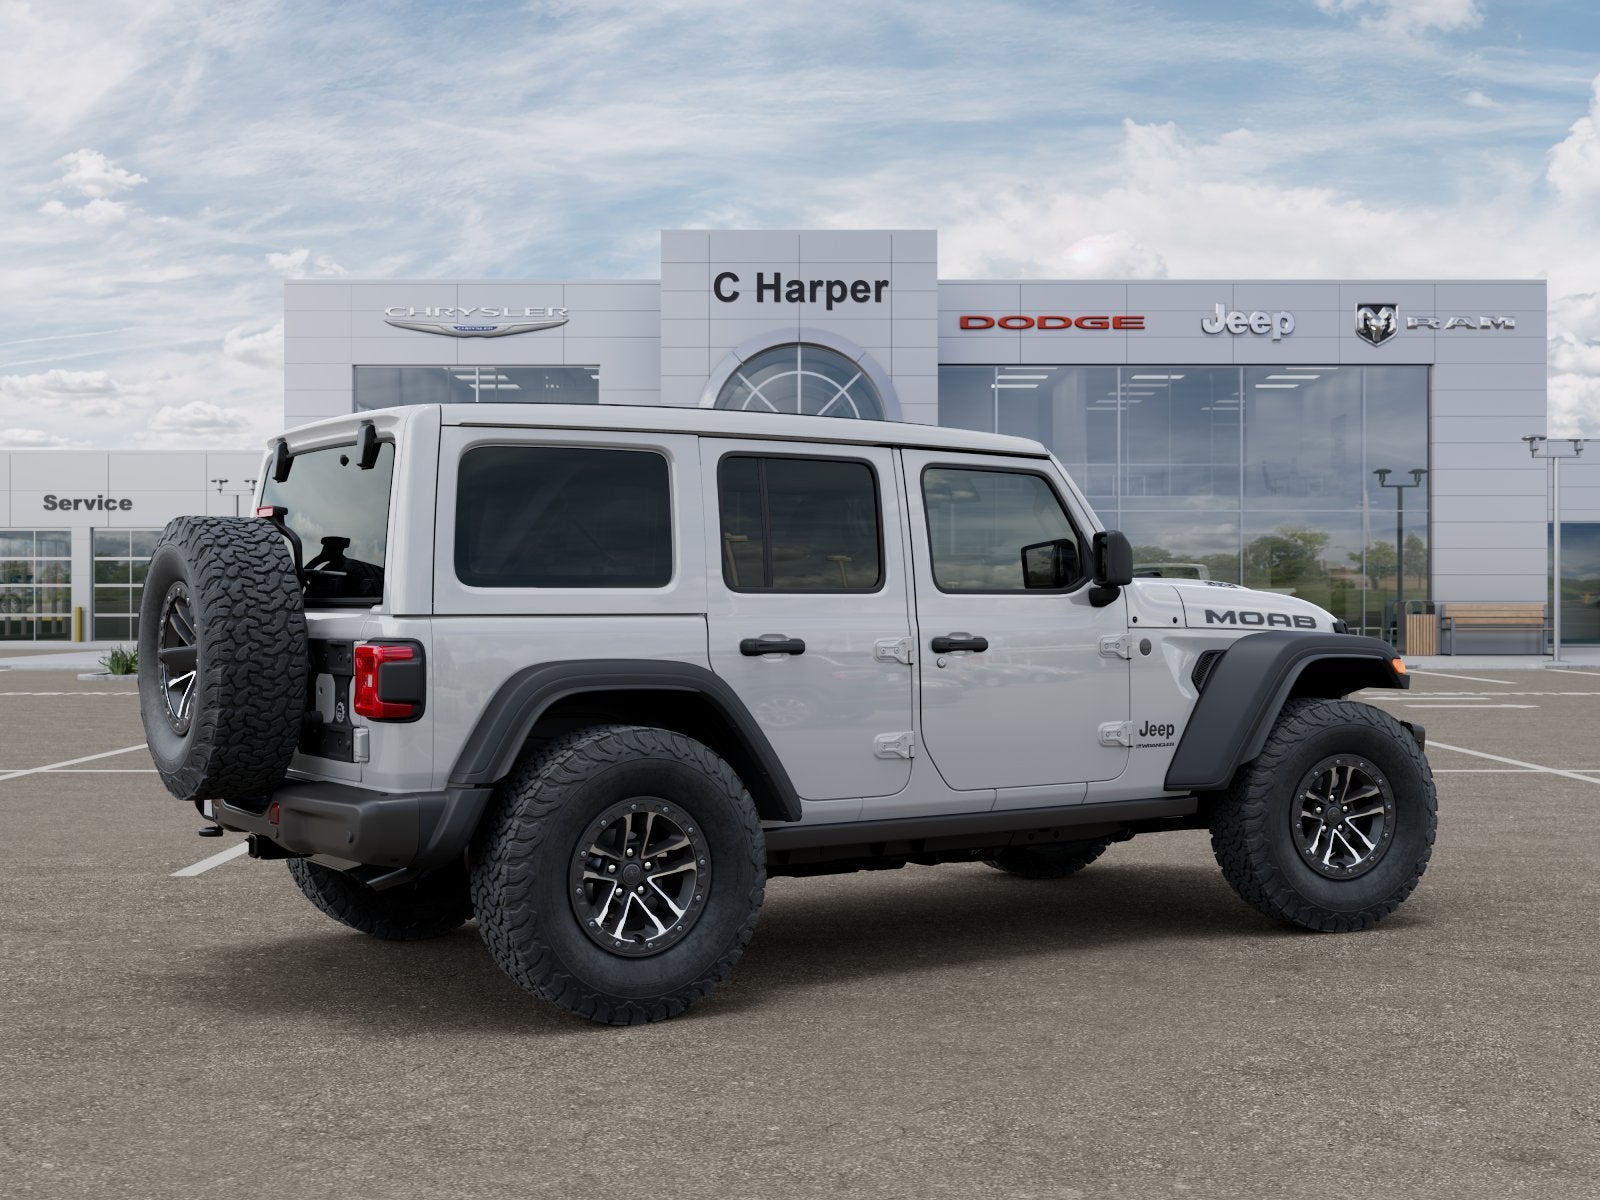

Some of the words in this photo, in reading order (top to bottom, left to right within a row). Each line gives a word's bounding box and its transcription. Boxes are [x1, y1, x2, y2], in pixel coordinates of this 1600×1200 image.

[713, 271, 740, 303] C
[756, 271, 891, 311] Harper
[384, 305, 569, 318] CHRYSLER
[959, 315, 1146, 331] DODGE
[1201, 303, 1295, 341] Jeep
[1406, 315, 1515, 330] RAM
[43, 494, 133, 511] Service
[1205, 609, 1317, 629] MOAB
[1139, 720, 1175, 739] Jeep
